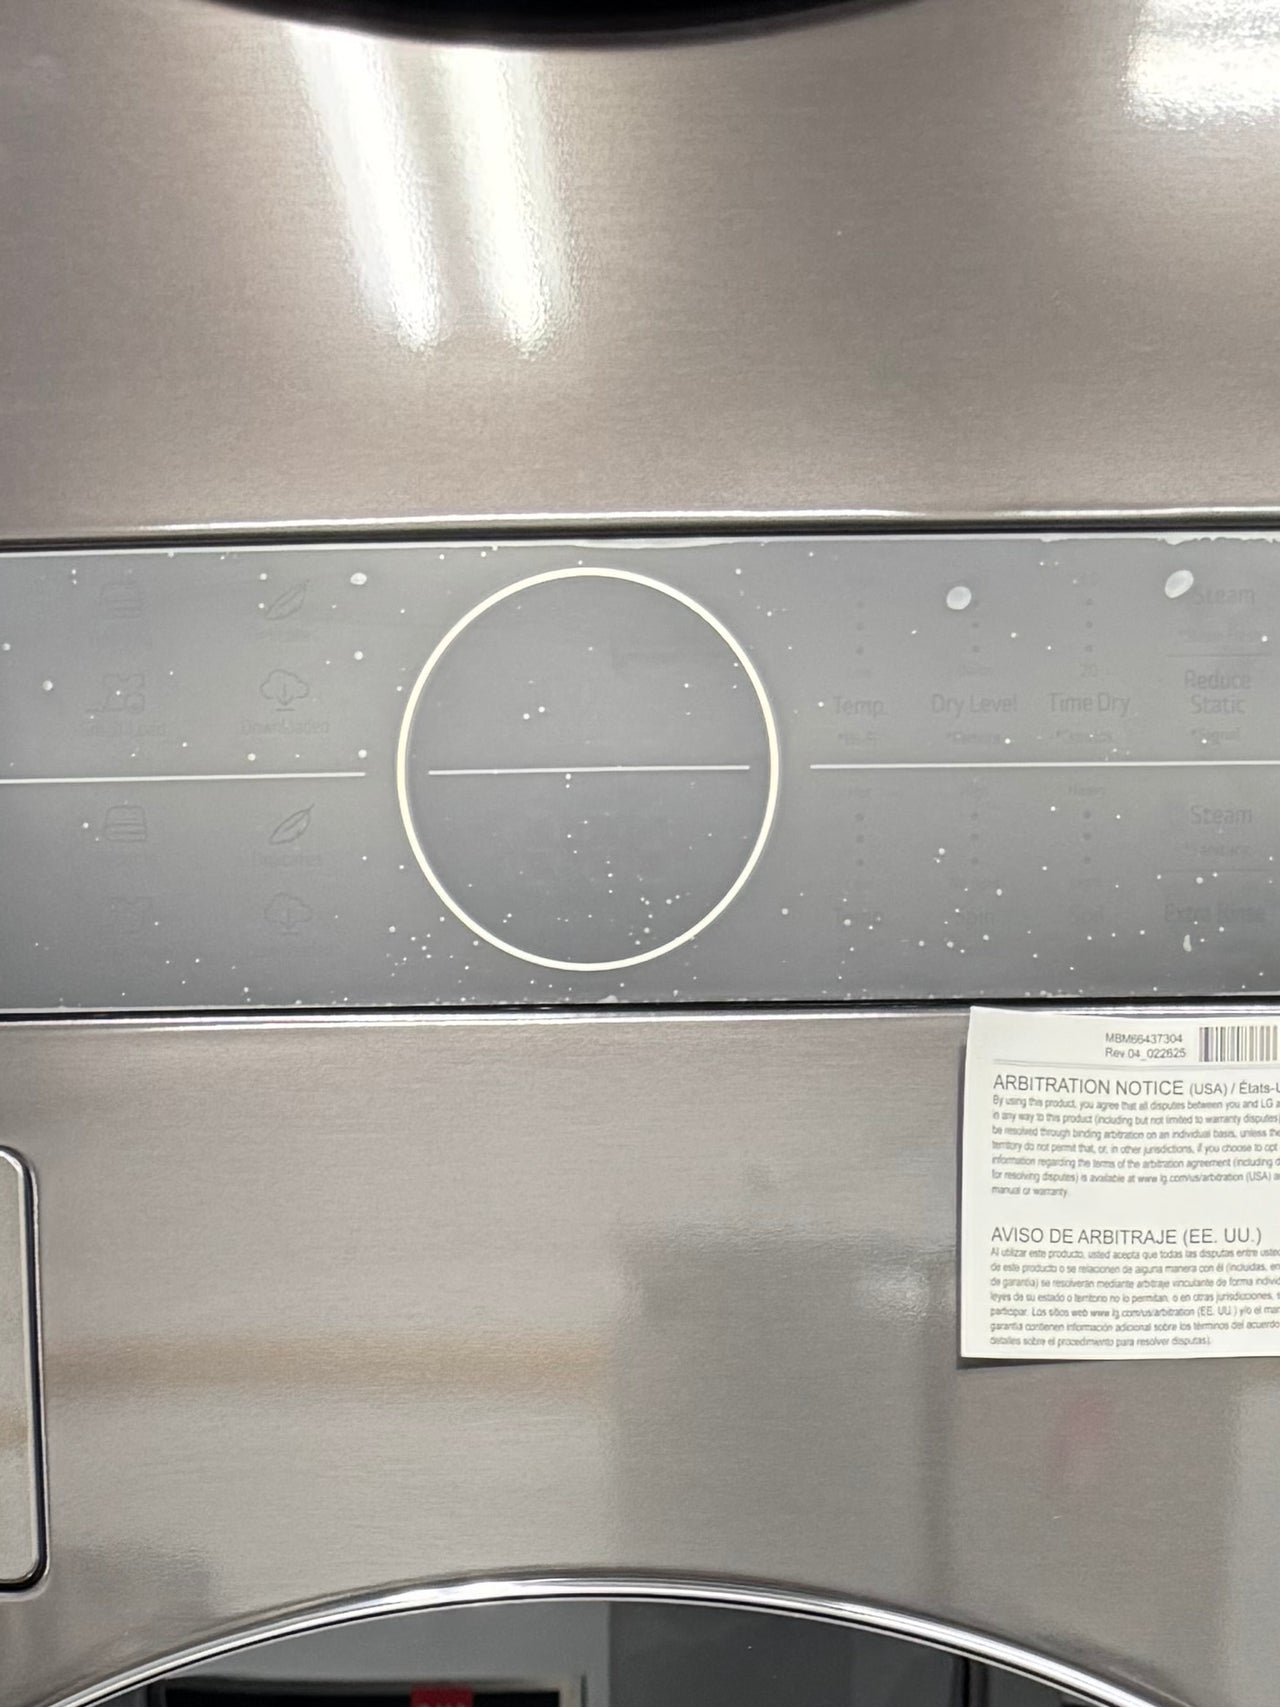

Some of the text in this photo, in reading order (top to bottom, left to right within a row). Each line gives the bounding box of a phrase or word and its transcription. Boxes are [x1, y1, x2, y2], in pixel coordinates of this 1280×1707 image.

[993, 1075, 1110, 1095] ARBITRATION
[1116, 1080, 1184, 1096] NOTICE
[1190, 1083, 1227, 1096] (USA)
[991, 1227, 1261, 1247] AVISO DE ARBITRAJE (EE. UU.)
